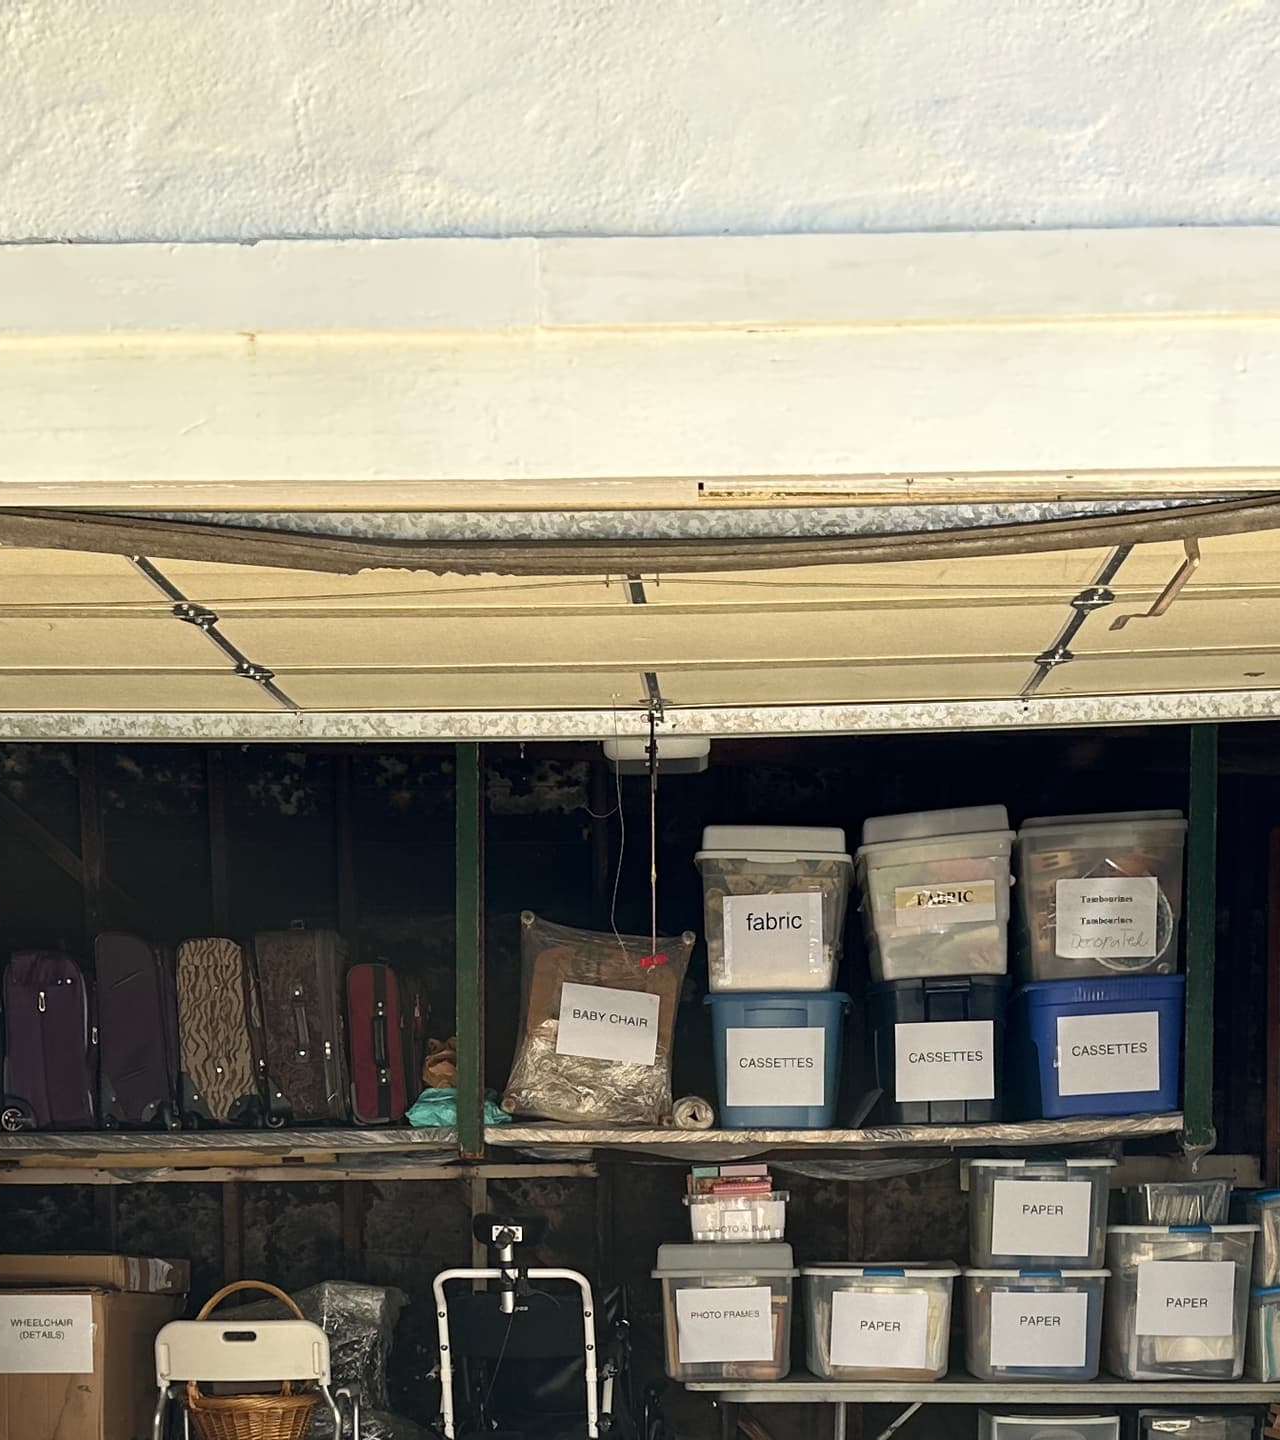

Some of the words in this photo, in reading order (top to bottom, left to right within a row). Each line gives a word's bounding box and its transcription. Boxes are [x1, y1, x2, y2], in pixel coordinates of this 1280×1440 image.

[746, 912, 802, 931] fabric
[1081, 917, 1133, 925] Tambourines
[572, 1008, 607, 1021] BABY
[609, 1014, 649, 1028] CHAIR
[1072, 1042, 1148, 1057] CASSETTES
[908, 1050, 983, 1063] CASSETTES
[739, 1057, 814, 1069] CASSETTES
[1023, 1204, 1063, 1215] PAPER
[1166, 1297, 1209, 1308] PAPER
[691, 1311, 721, 1319] PHOTO
[724, 1310, 760, 1319] FRAMES
[10, 1319, 73, 1327] WHEELCHAIR
[860, 1320, 901, 1332] PAPER
[1020, 1316, 1061, 1327] PAPER
[19, 1331, 65, 1340] (DETAILS)
